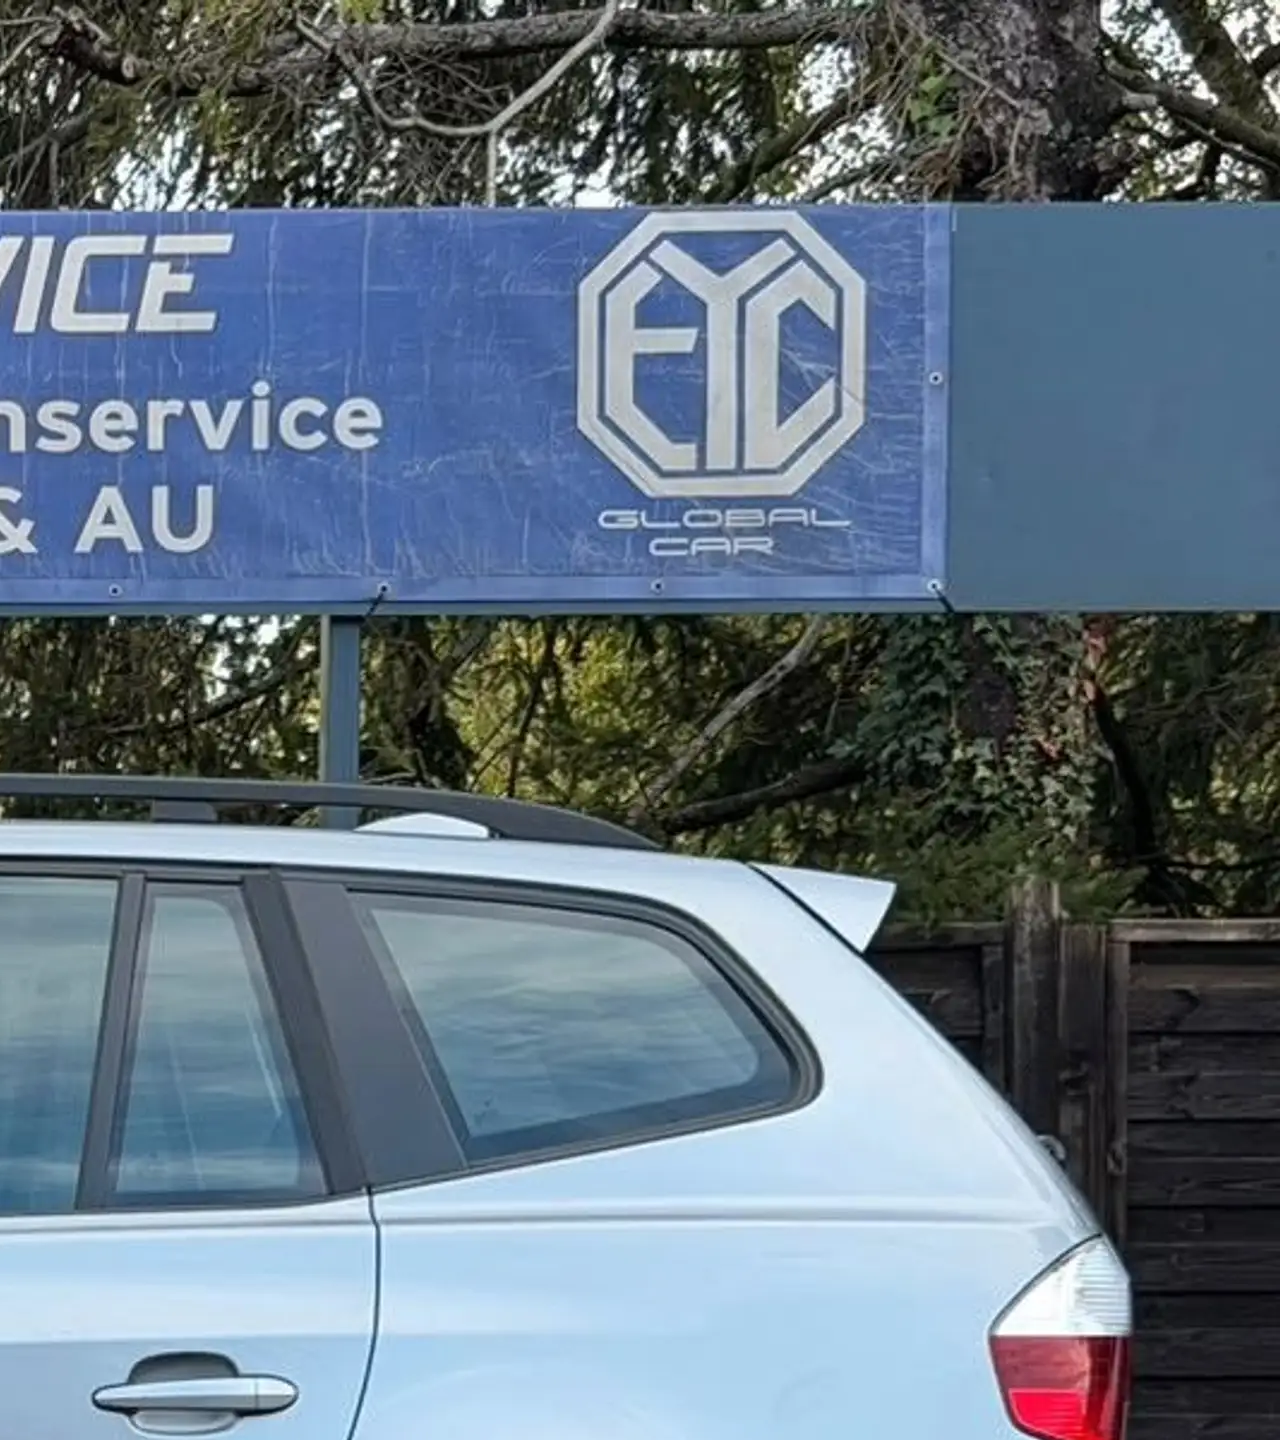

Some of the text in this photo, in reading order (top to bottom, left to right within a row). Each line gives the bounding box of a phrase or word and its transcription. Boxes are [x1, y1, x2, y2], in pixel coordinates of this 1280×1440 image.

[75, 484, 214, 553] AU
[598, 507, 851, 529] GLOBAL
[648, 537, 774, 556] CAR
